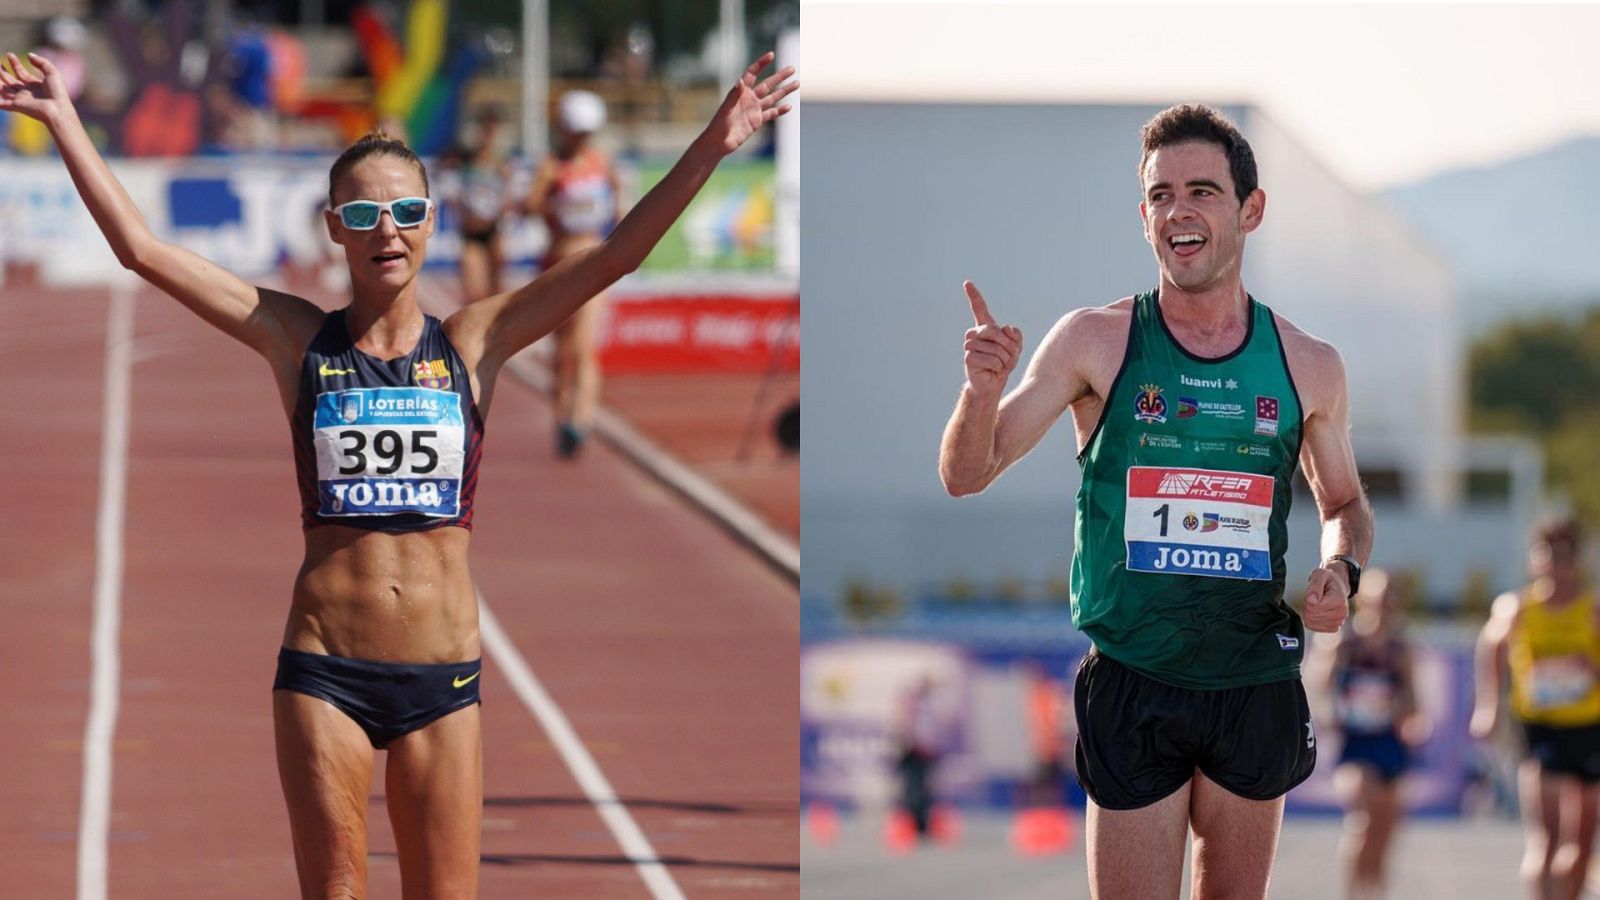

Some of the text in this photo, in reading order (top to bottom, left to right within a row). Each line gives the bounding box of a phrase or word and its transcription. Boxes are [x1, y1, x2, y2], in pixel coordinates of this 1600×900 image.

[1180, 374, 1222, 389] luanvi
[368, 395, 438, 410] LOTERÍAS
[339, 429, 439, 475] 395
[1193, 475, 1252, 490] RFEA
[1189, 488, 1248, 500] ATLETISMO
[1152, 503, 1169, 537] 1
